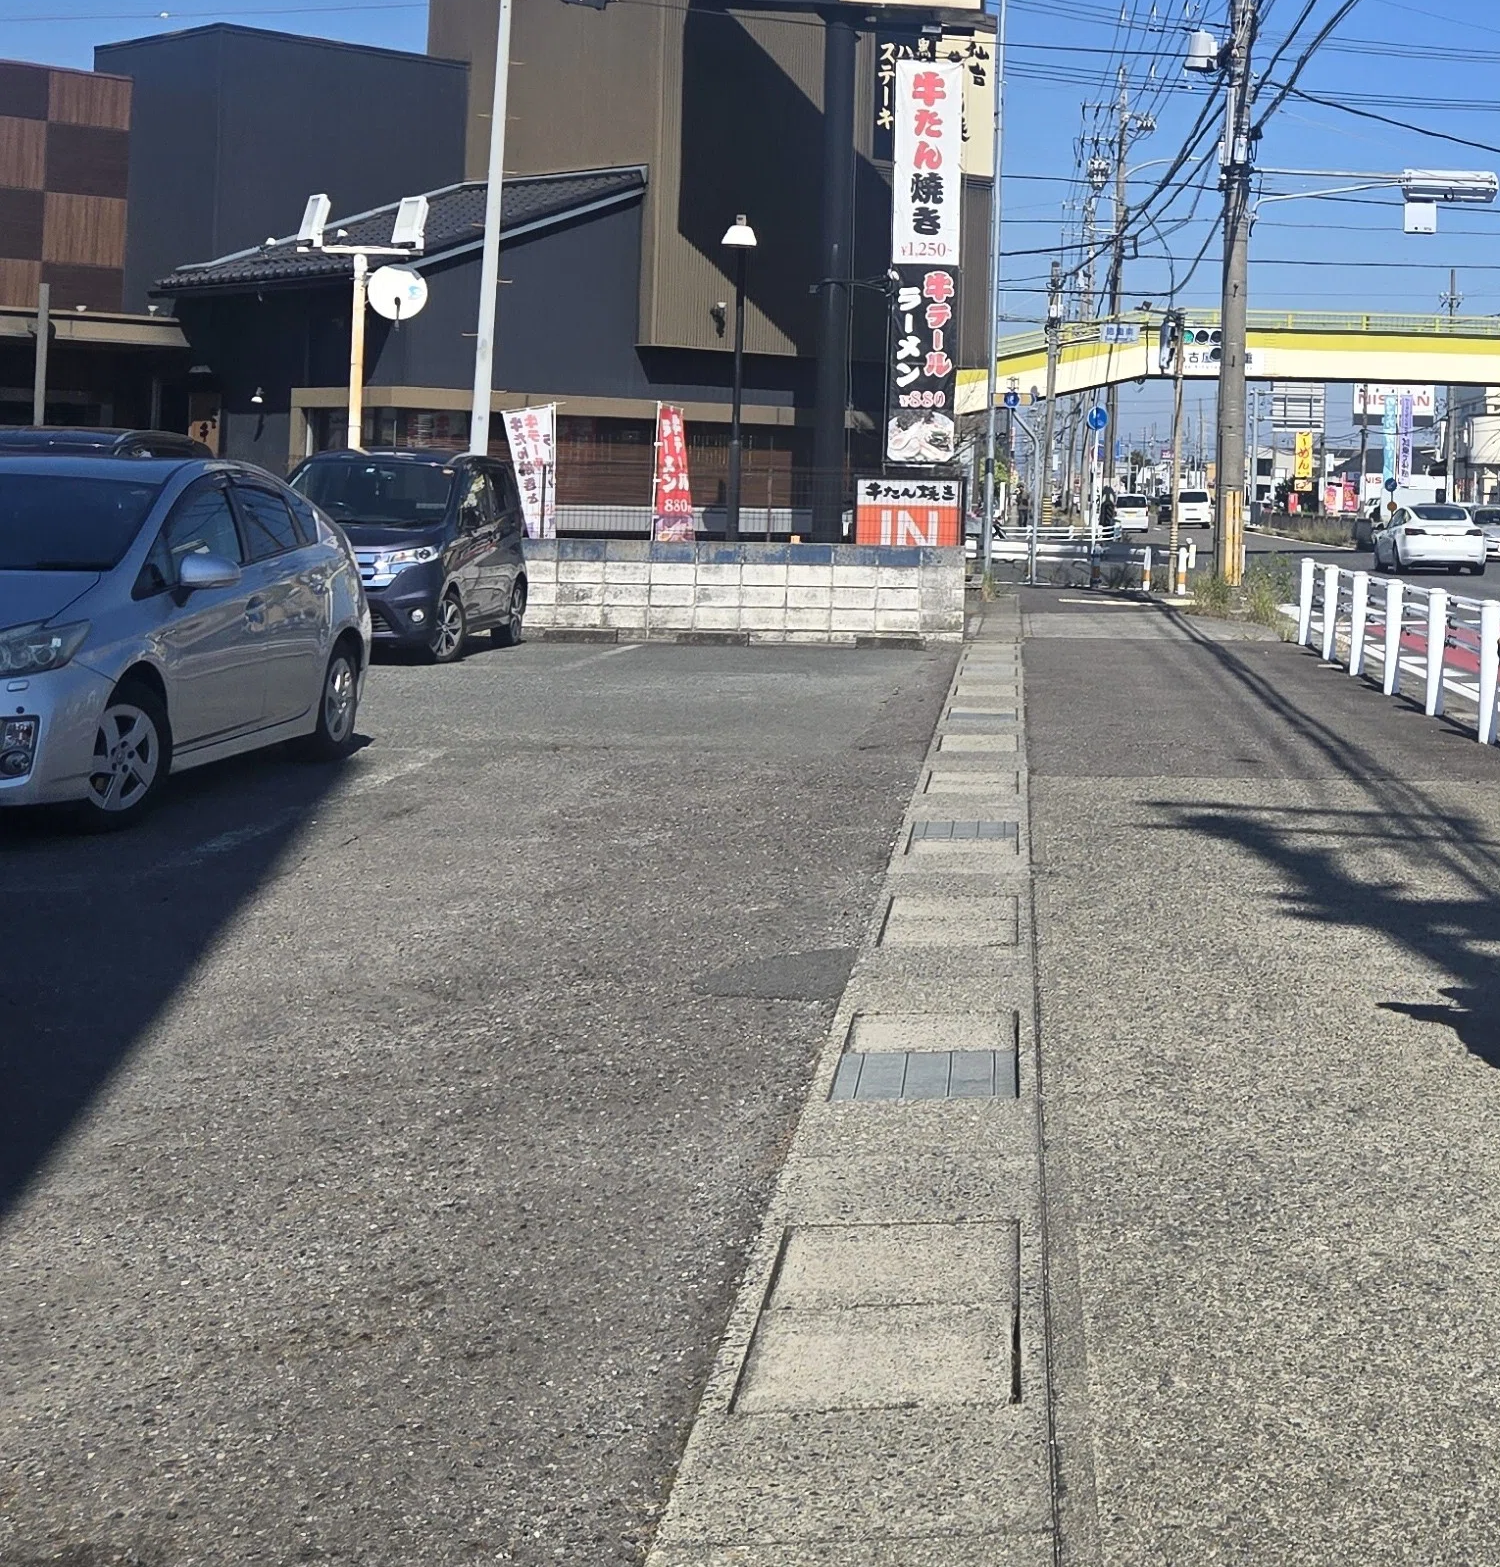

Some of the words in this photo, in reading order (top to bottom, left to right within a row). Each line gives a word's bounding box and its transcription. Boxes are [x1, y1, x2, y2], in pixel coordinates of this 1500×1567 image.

[876, 42, 897, 131] ステーキ
[965, 41, 990, 87] 仙台
[910, 70, 947, 236] 牛たん焼き
[896, 286, 922, 388] ラーメン
[923, 270, 954, 378] 牛テール
[660, 418, 679, 494] ラーメン
[865, 483, 956, 502] 牛たん焼き
[880, 509, 940, 547] IN
